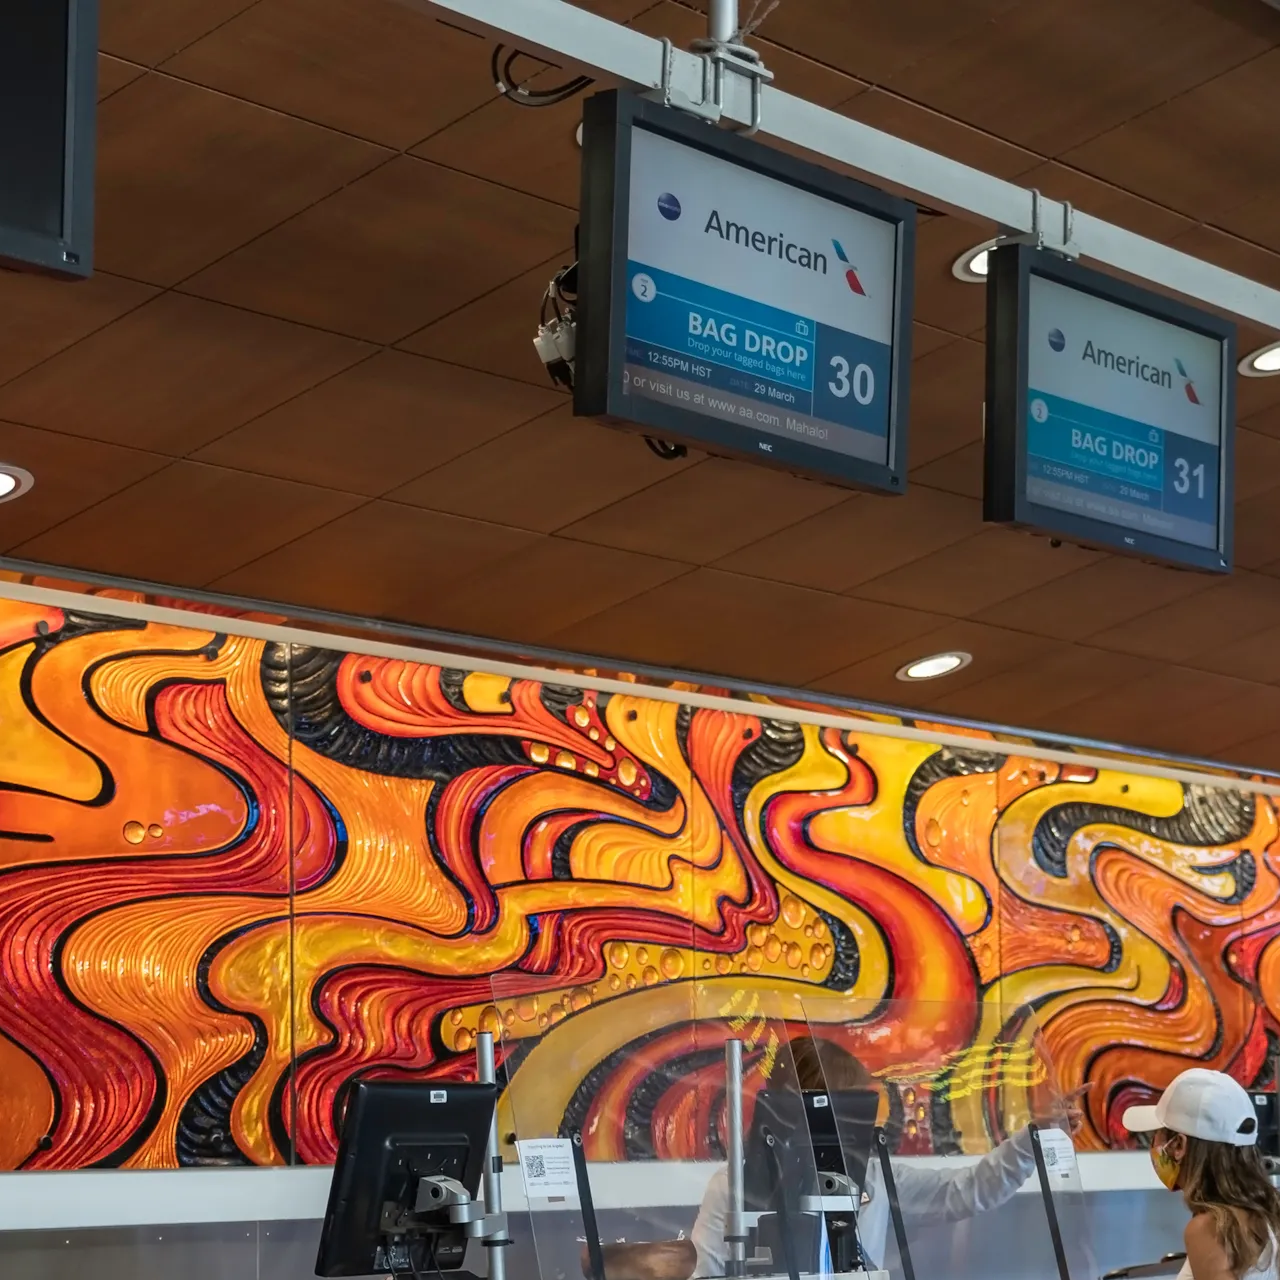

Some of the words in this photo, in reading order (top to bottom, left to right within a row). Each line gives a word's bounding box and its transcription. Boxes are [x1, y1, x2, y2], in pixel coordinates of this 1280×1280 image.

[704, 210, 827, 275] American
[640, 284, 648, 298] 2
[687, 337, 710, 353] Drop
[711, 345, 733, 359] your
[734, 353, 764, 369] tagged
[765, 360, 785, 376] bags
[786, 365, 806, 382] here
[688, 312, 737, 347] BAG
[744, 329, 808, 367] DROP
[648, 351, 689, 373] 12:55PM
[691, 363, 713, 379] HST
[754, 383, 766, 395] 29
[767, 386, 795, 403] March
[828, 355, 875, 406] 30
[1081, 340, 1172, 389] American
[633, 376, 646, 388] or
[649, 380, 673, 397] visit
[676, 388, 691, 401] us
[693, 393, 705, 405] at
[786, 417, 829, 441] Mahalo!
[1036, 408, 1043, 419] 2
[758, 442, 773, 452] NEC
[1071, 428, 1107, 457] BAG
[1112, 440, 1159, 470] DROP
[1173, 457, 1205, 499] 31
[1124, 536, 1135, 545] NEC
